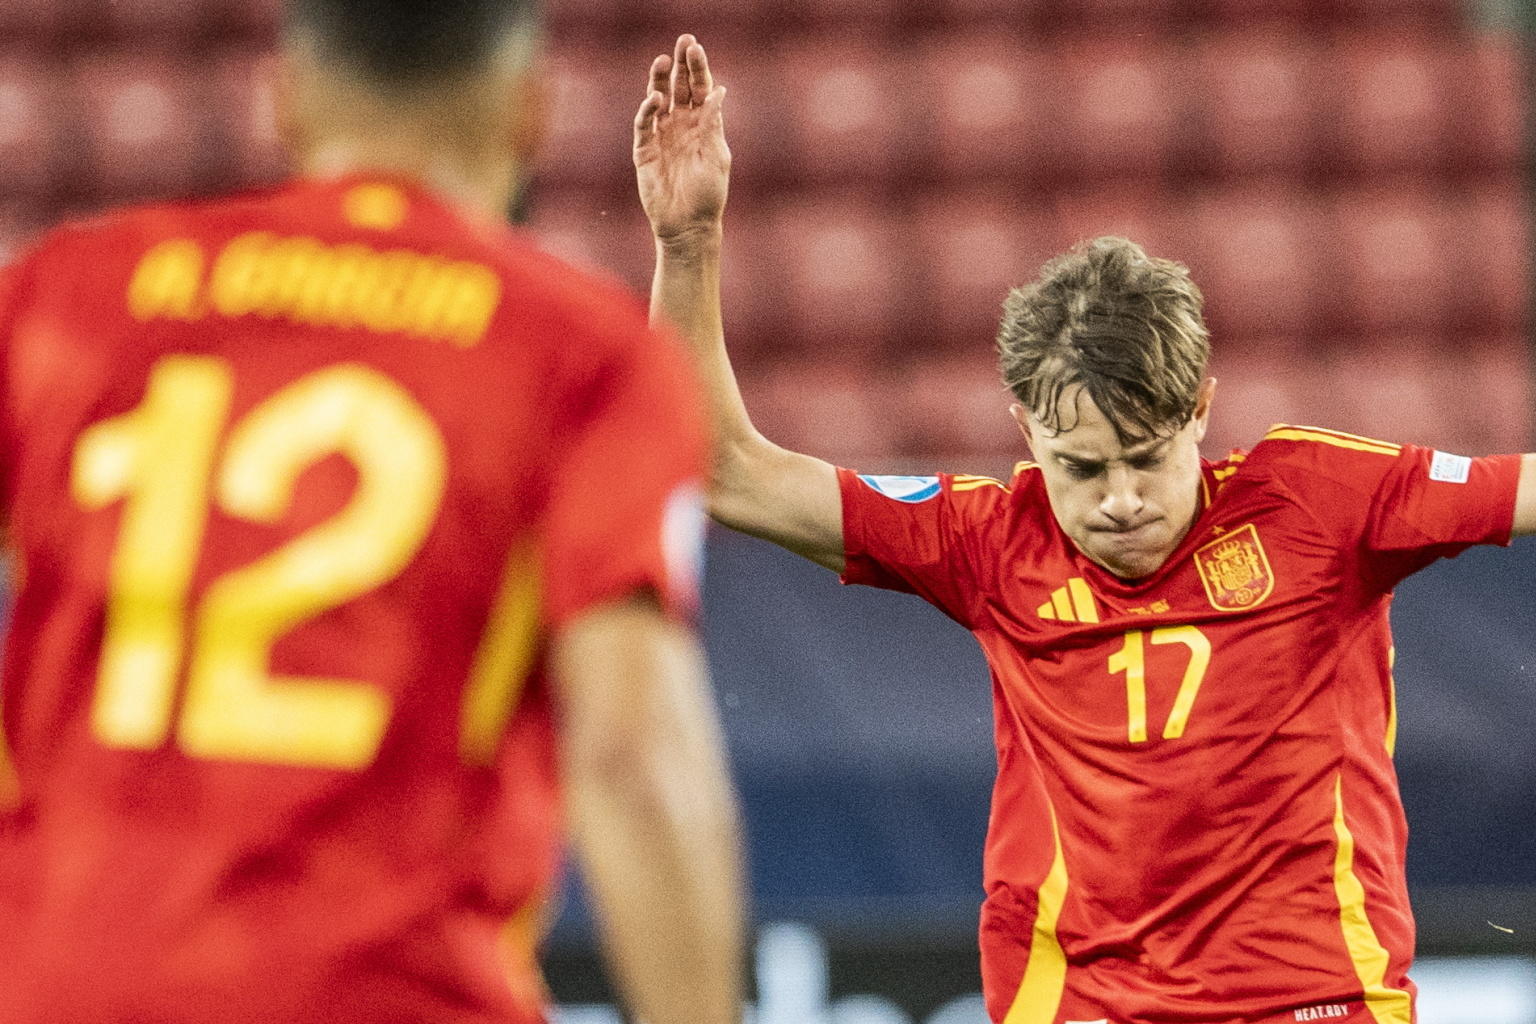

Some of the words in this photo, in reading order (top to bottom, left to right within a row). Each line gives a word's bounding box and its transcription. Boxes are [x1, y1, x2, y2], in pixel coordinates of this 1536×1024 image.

[70, 355, 447, 771] 12
[1108, 625, 1212, 743] 17
[1294, 1004, 1349, 1022] HEAT.RDY
